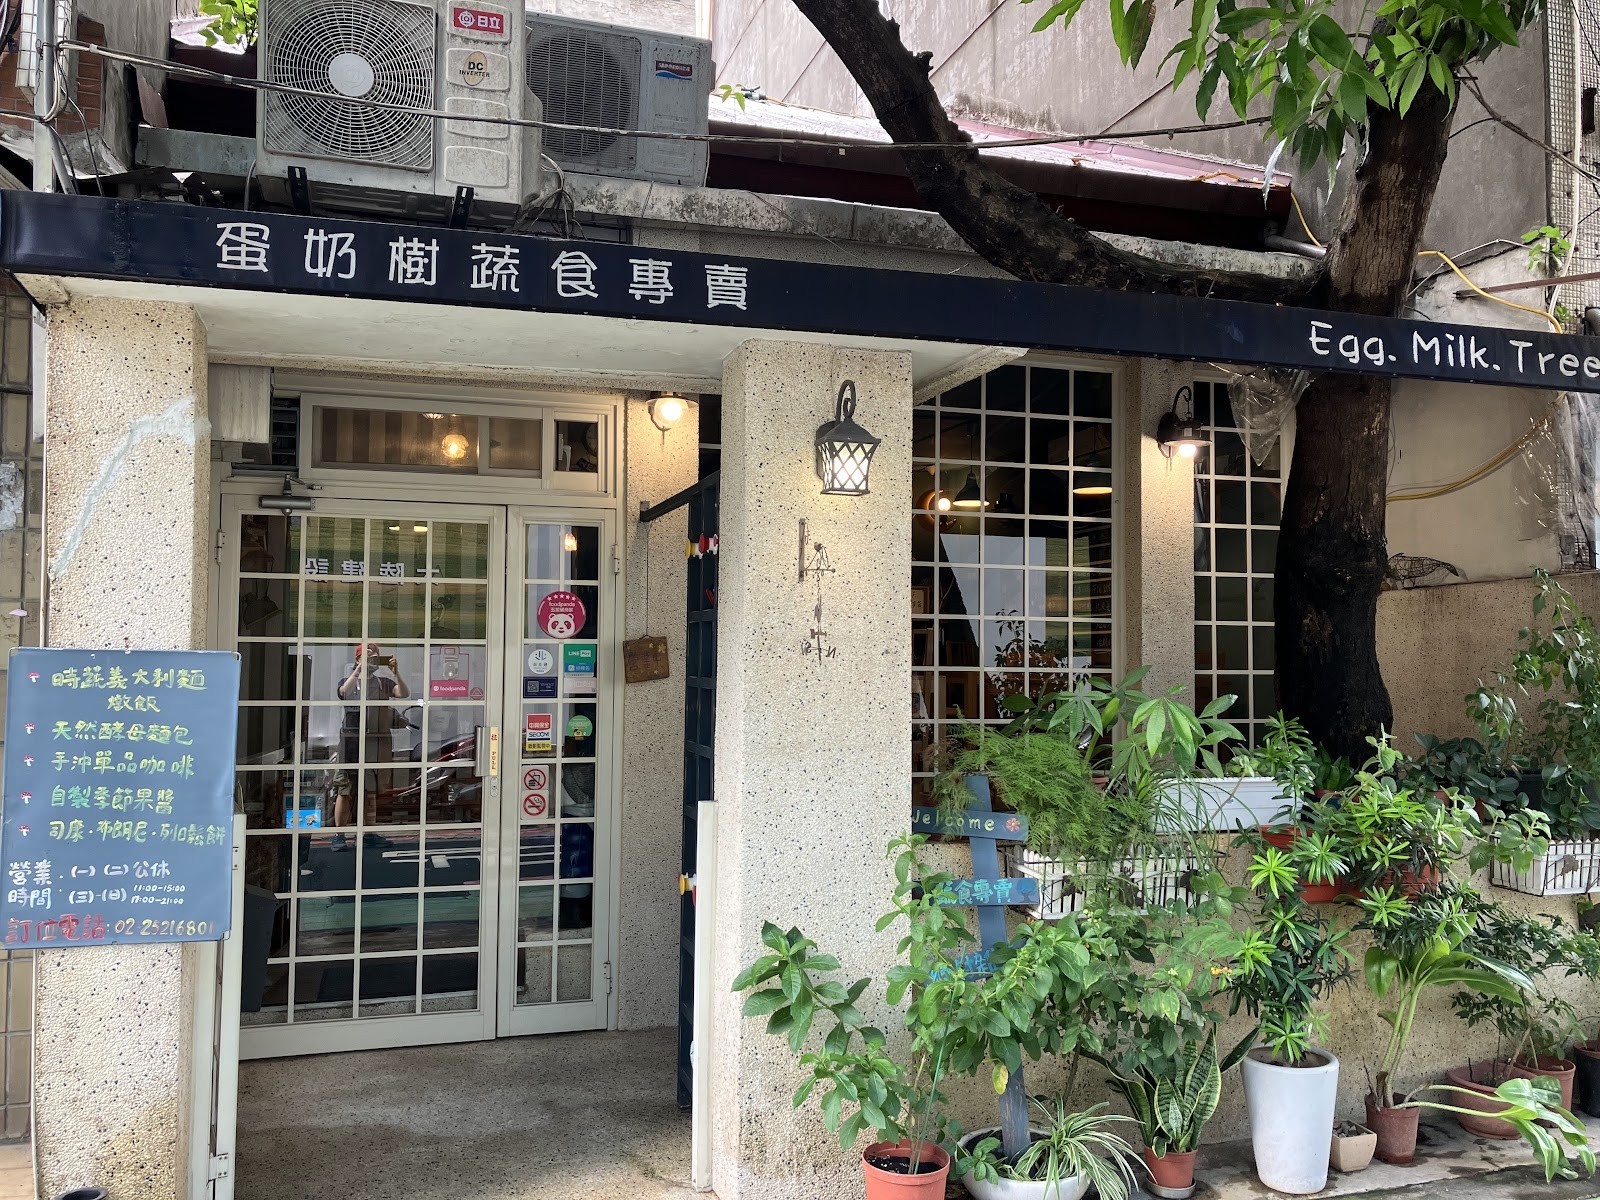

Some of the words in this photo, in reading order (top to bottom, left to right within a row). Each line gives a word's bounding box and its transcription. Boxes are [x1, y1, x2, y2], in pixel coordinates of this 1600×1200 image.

[477, 15, 501, 29] 日立
[459, 69, 490, 78] INVERTER
[467, 61, 484, 71] DC
[215, 221, 749, 311] 蛋奶樹蔬食專賣
[1308, 320, 1397, 366] Egg.
[1411, 330, 1501, 371] Milk.
[1509, 339, 1600, 378] Tree
[51, 719, 194, 745] 天然酵母麵包
[51, 750, 195, 780] 手沖單品咖啡
[51, 784, 175, 815] 自製季節果醬
[133, 884, 186, 893] 11:00-15:00
